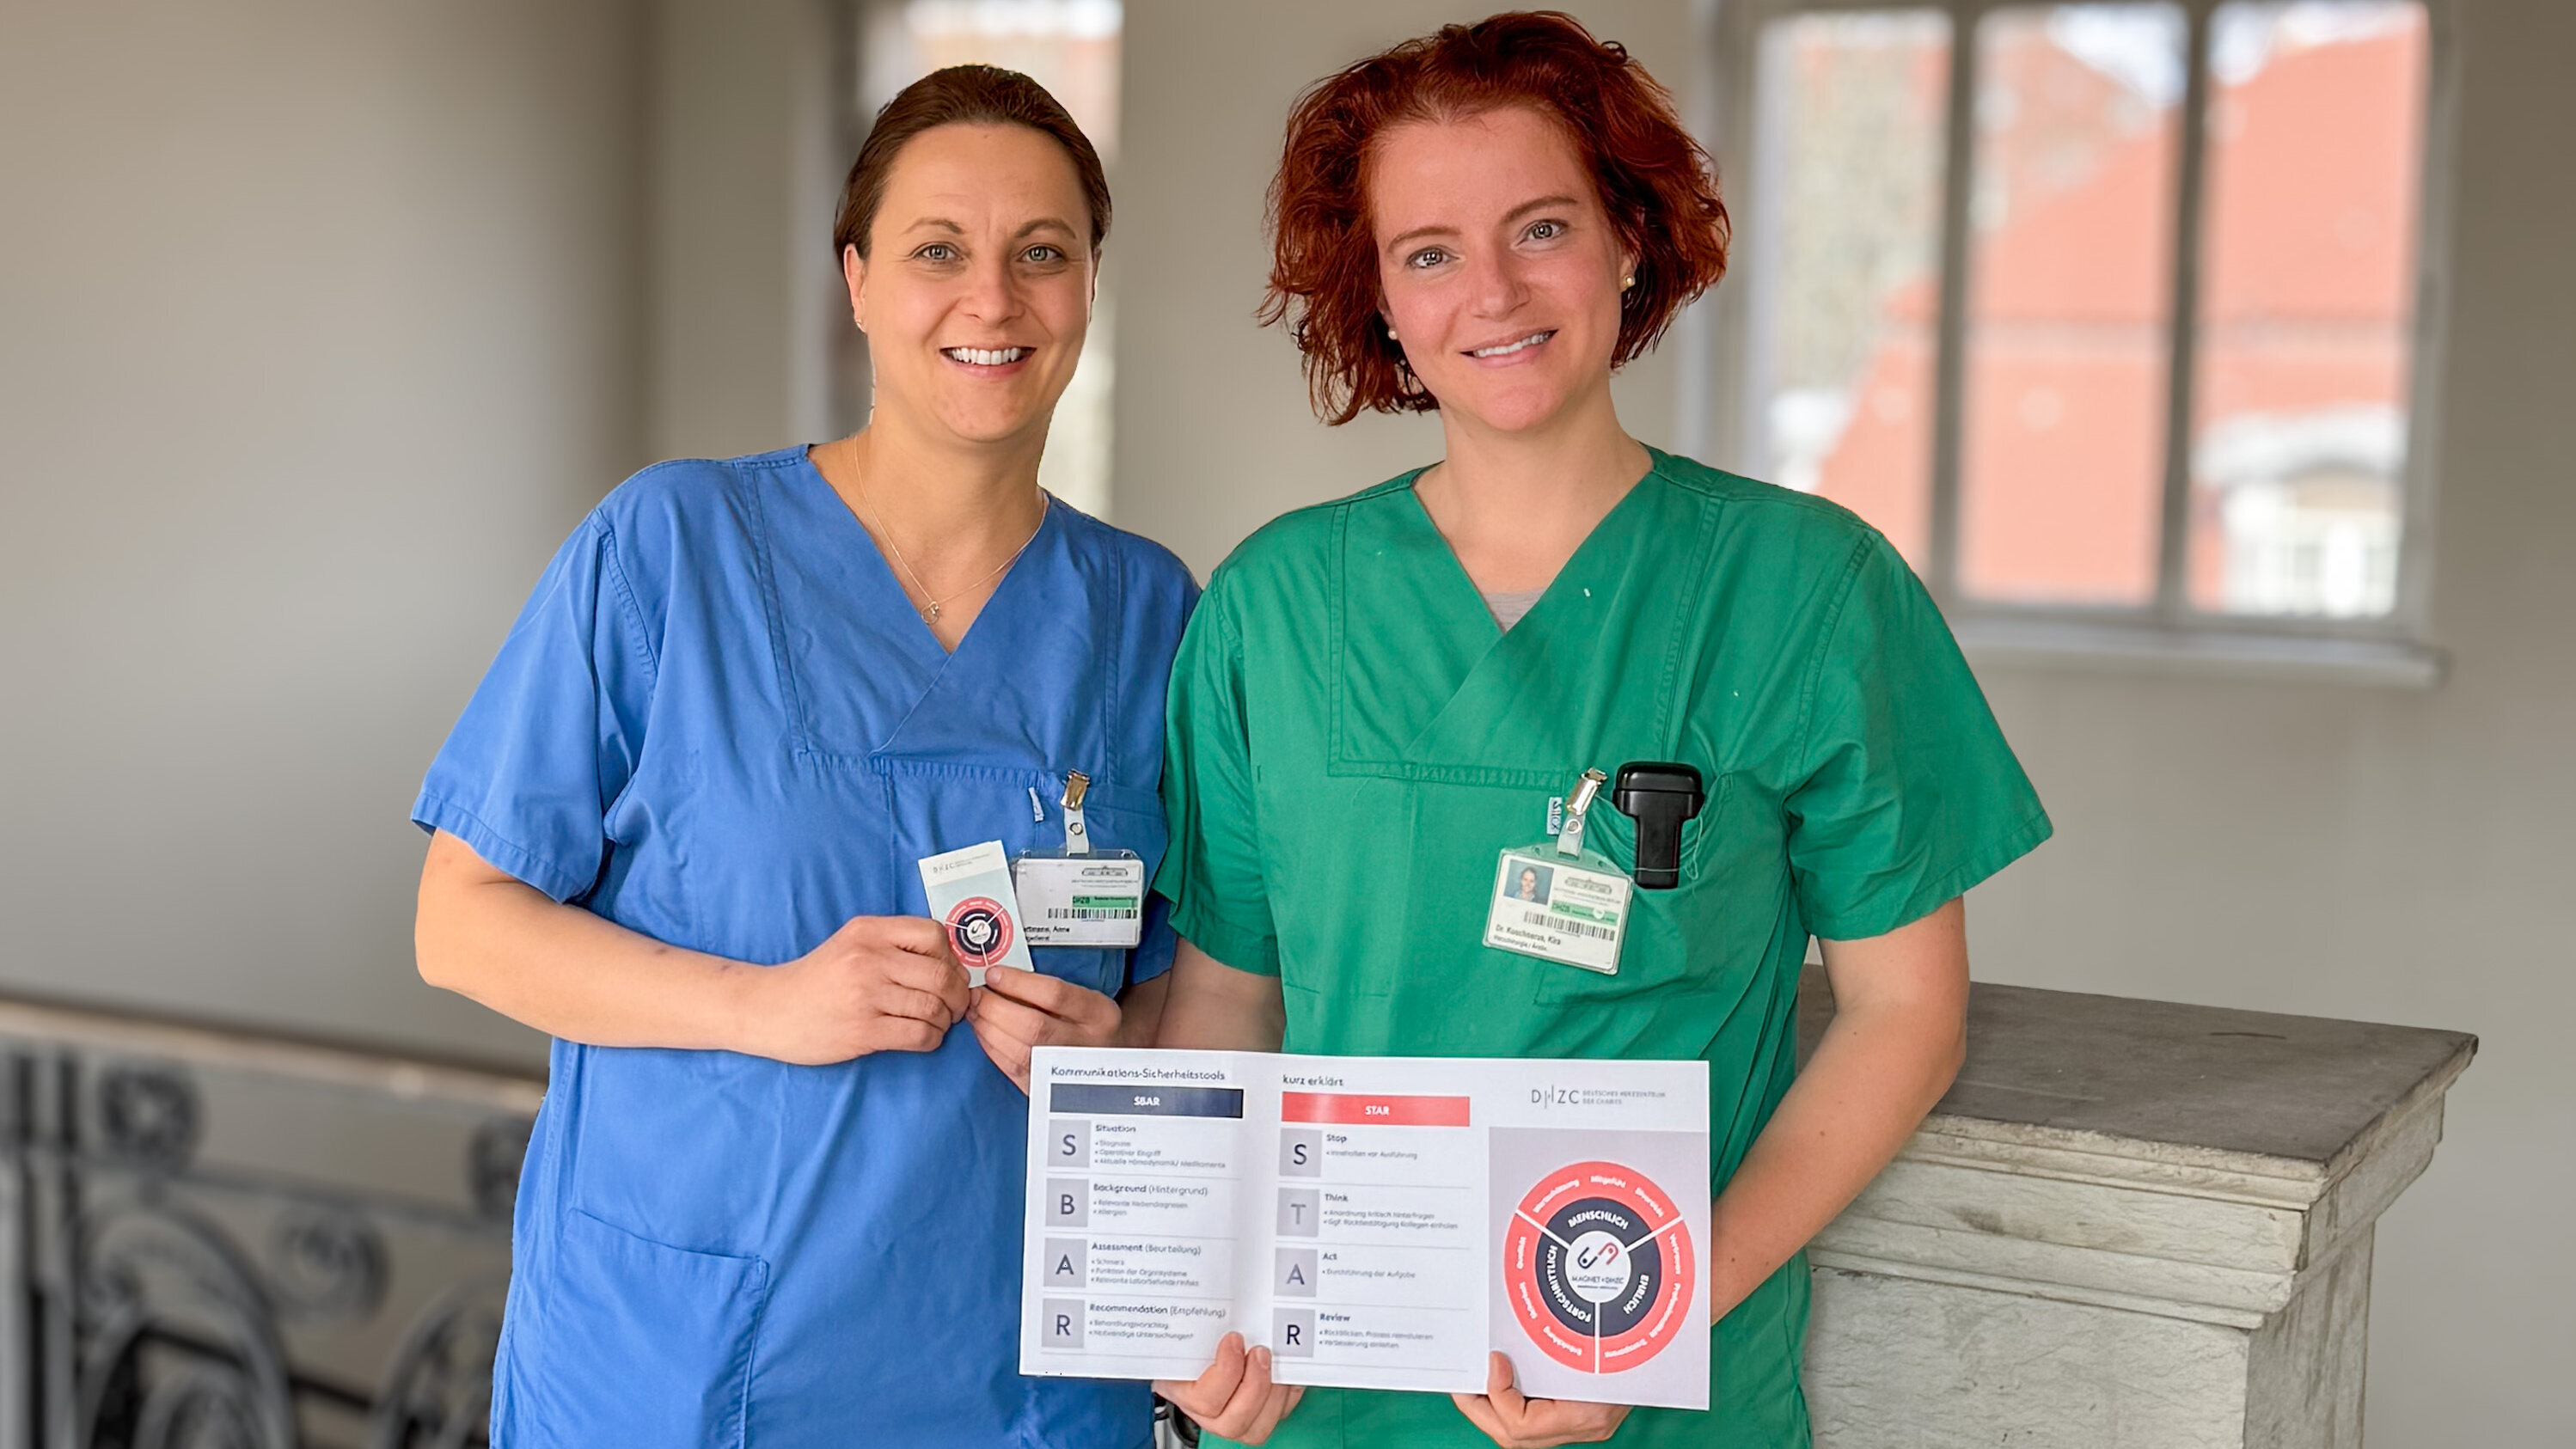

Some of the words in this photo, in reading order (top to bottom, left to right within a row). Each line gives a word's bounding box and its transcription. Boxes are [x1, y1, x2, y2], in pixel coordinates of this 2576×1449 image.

[1051, 1066, 1225, 1080] Kommunikations-Sicherheitstools
[1282, 1074, 1305, 1085] kurz
[1308, 1075, 1343, 1086] erklärt
[1133, 1096, 1160, 1107] SBAR
[1364, 1105, 1390, 1116] STAR
[1095, 1124, 1136, 1133] Situation
[1062, 1134, 1076, 1156] S
[1326, 1134, 1348, 1144] Stop
[1293, 1144, 1307, 1165] S
[1093, 1183, 1147, 1194] Background
[1148, 1185, 1208, 1197] (Hintergrund)
[1060, 1194, 1075, 1215] B
[1325, 1193, 1349, 1202] Think
[1290, 1204, 1306, 1225] T
[1568, 1210, 1629, 1230] MENSCHLICH
[1092, 1243, 1143, 1251] Assessment
[1145, 1244, 1202, 1256] (Beurteilung)
[1322, 1252, 1337, 1261] Act
[1055, 1254, 1074, 1275] A
[1286, 1263, 1306, 1285] A
[1547, 1244, 1592, 1323] FORTSCHRITTLICH
[1623, 1275, 1649, 1315] EHRLICH
[1090, 1304, 1168, 1314] Recommendation
[1170, 1306, 1227, 1318] (Empfehlung)
[1319, 1313, 1350, 1322] Review
[1055, 1314, 1071, 1336] R
[1286, 1324, 1301, 1346] R
